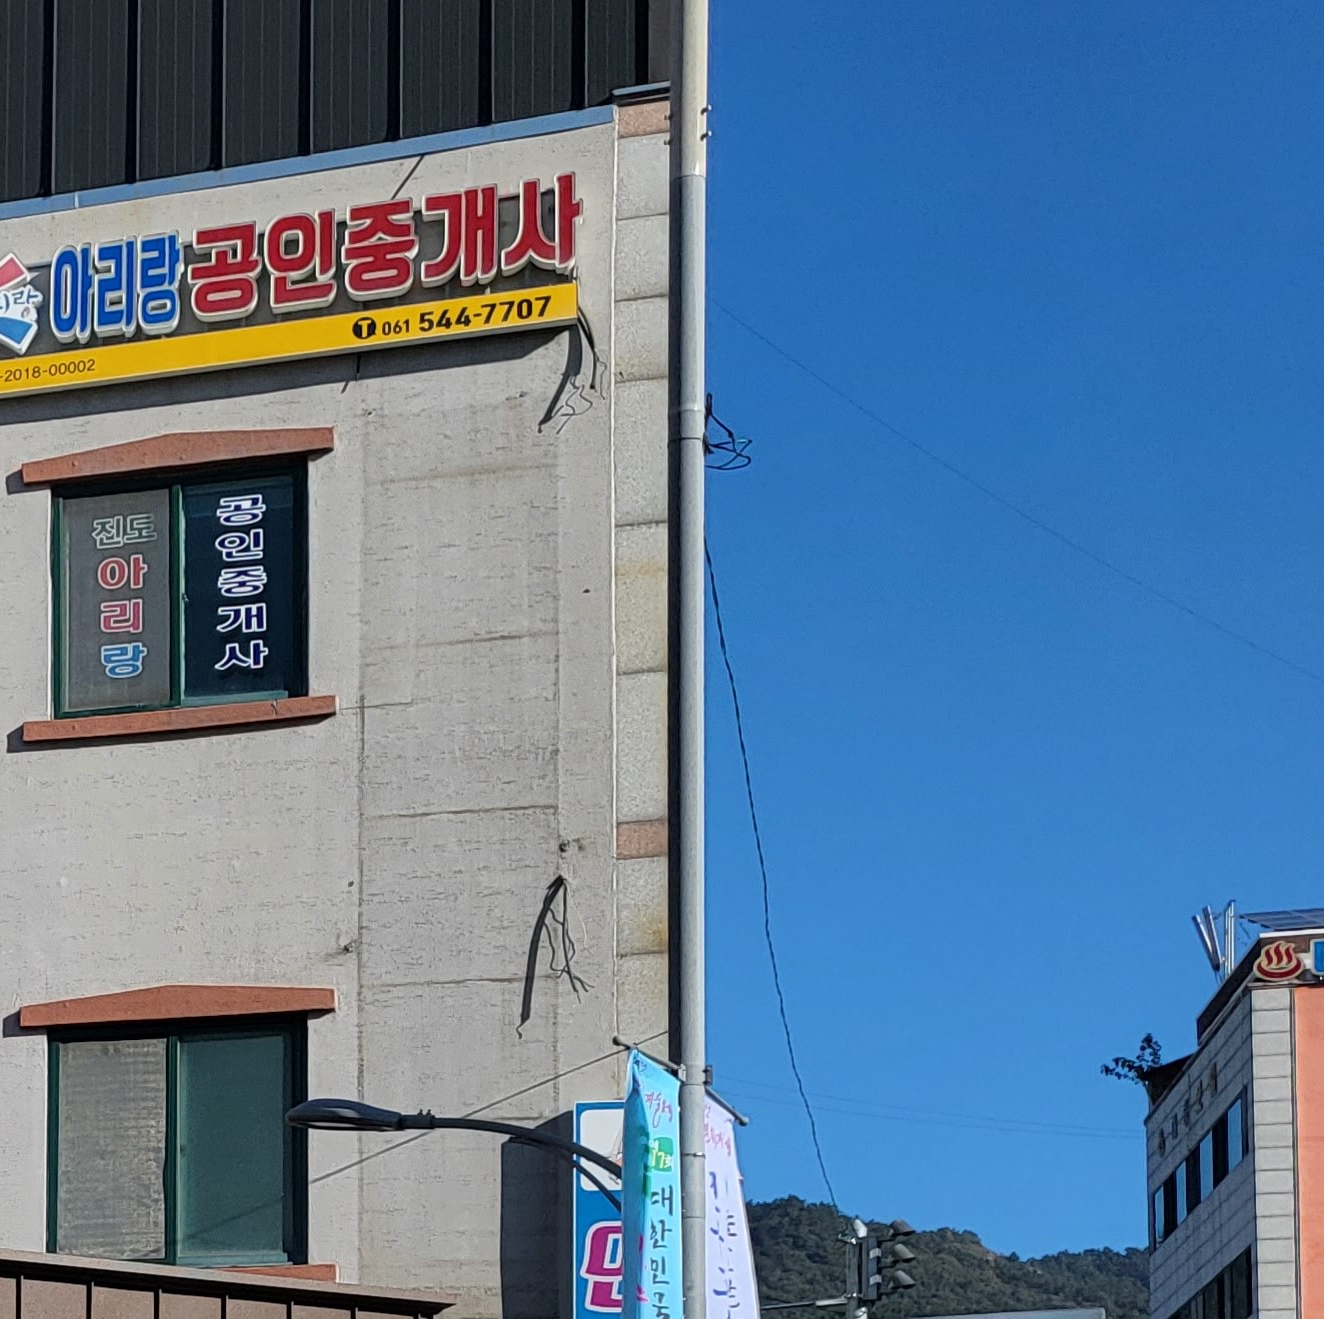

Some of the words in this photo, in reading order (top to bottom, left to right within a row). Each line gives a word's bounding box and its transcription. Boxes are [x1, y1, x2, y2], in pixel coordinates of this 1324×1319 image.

[51, 235, 182, 341] 아리랑
[189, 173, 583, 323] 공인중개사
[382, 319, 410, 336] 061
[419, 296, 552, 332] 544-7707
[92, 513, 157, 549] 진도
[215, 494, 268, 670] 공인중개사
[98, 554, 147, 678] 아리랑
